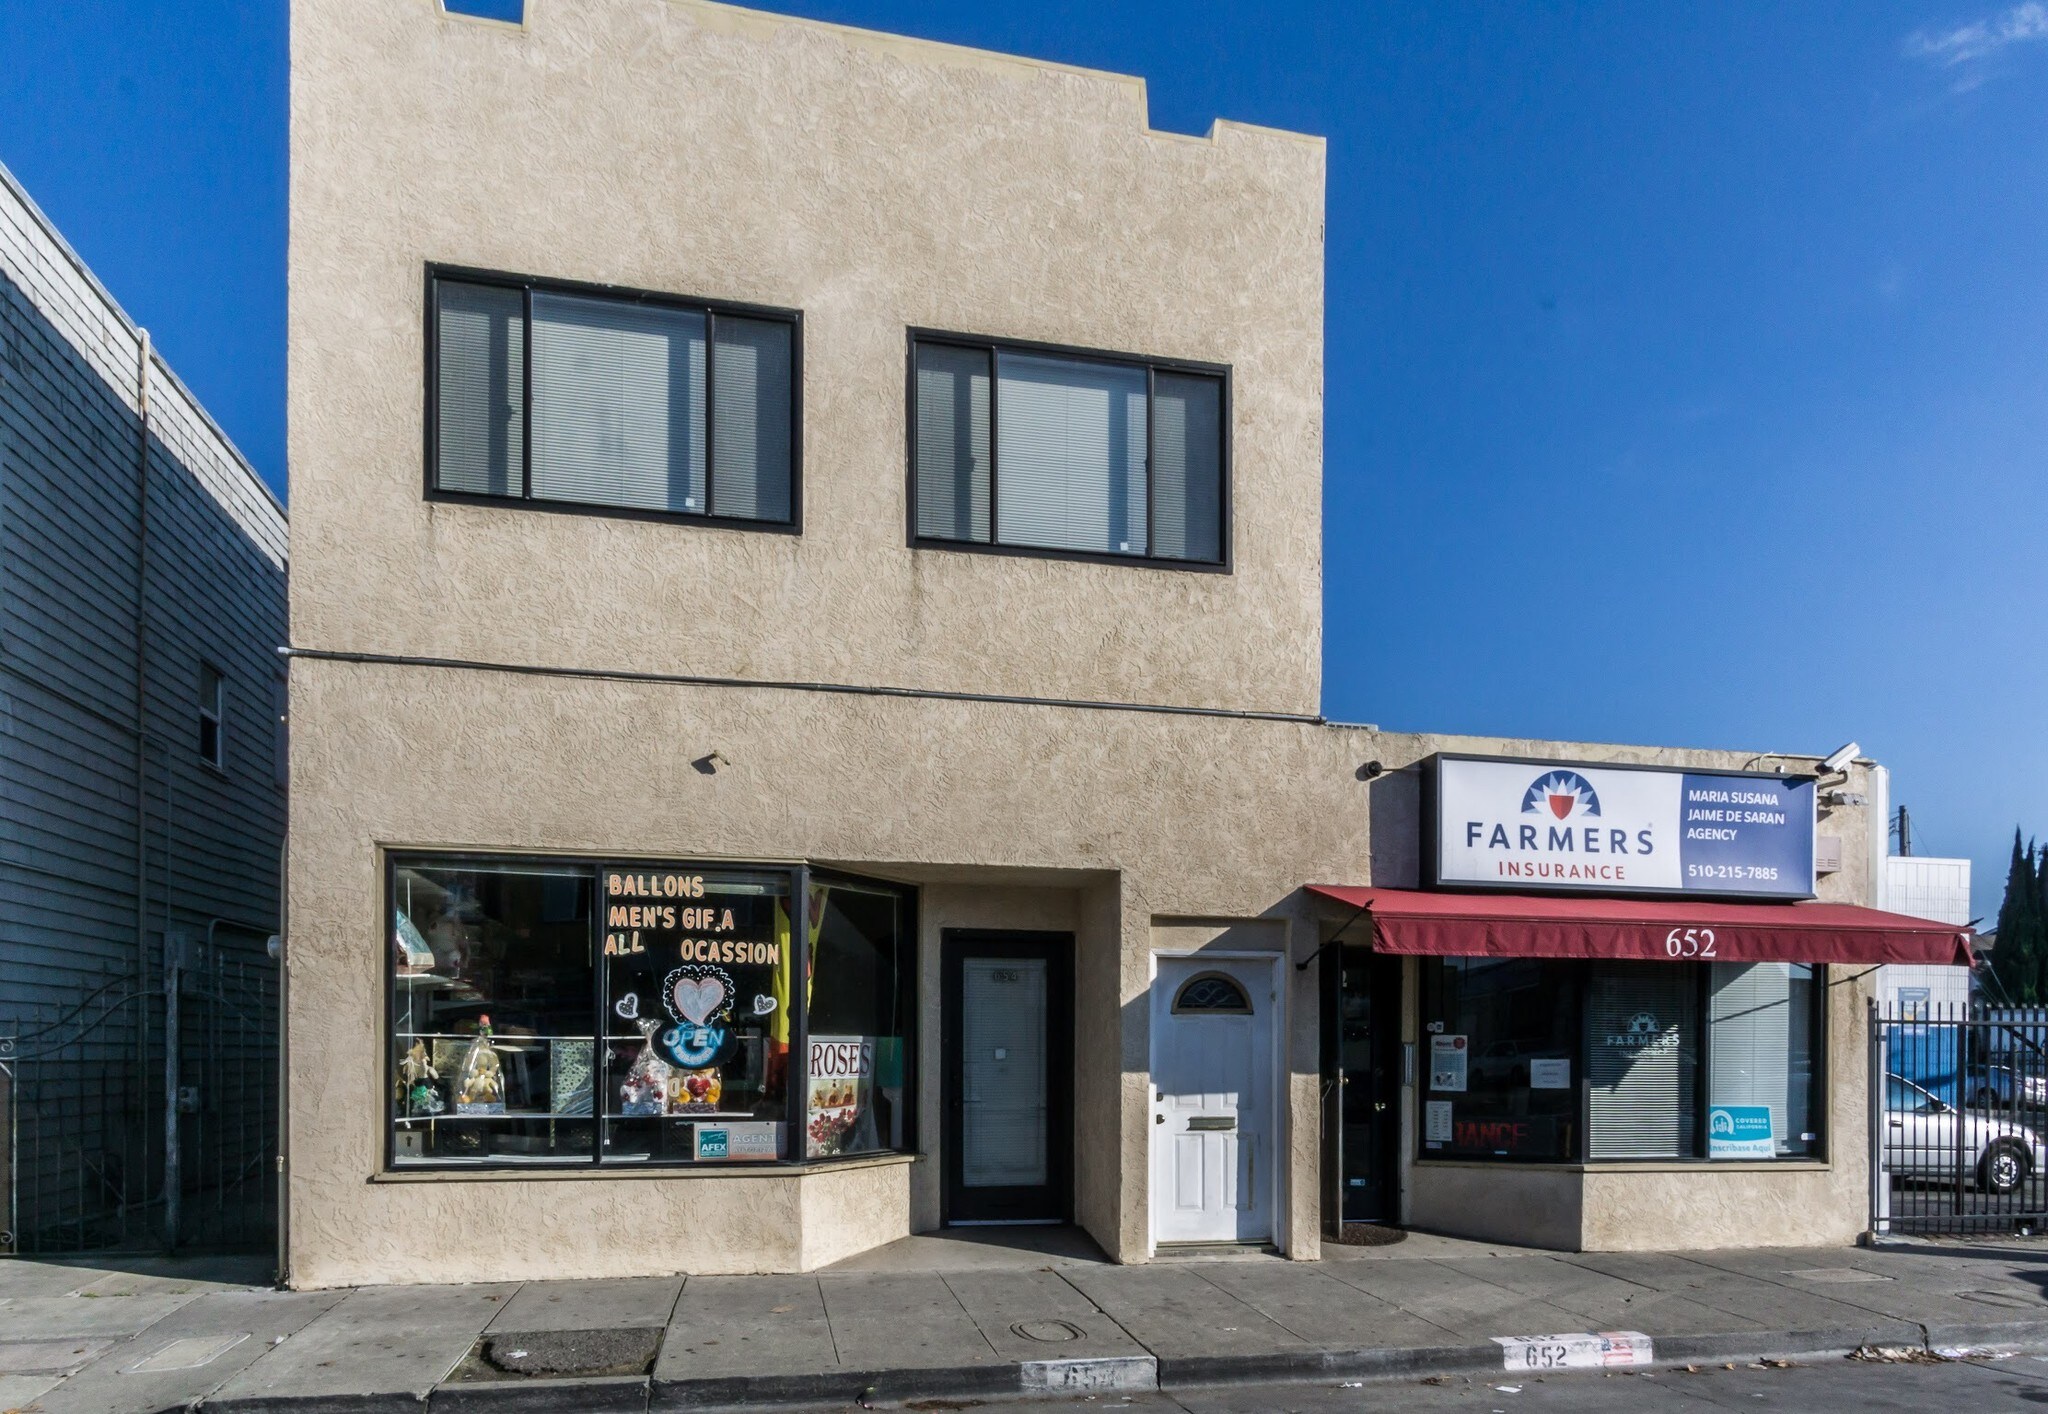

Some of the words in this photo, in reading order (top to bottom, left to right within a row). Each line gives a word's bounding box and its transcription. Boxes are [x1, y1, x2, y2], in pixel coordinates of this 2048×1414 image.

[1689, 790, 1729, 803] MARIA
[1731, 792, 1778, 806] SUSANA
[1688, 809, 1723, 822] JAIME
[1726, 810, 1742, 823] DE
[1744, 811, 1785, 825] SARAN
[1467, 822, 1653, 855] FARMERS
[1687, 828, 1737, 840] AGENCY
[1499, 861, 1625, 880] INSURANCE
[1688, 864, 1778, 880] 510-215-7885
[609, 874, 704, 898] BALLONS
[609, 906, 676, 929] MEN'S
[604, 930, 645, 956] ALL
[680, 938, 779, 965] OCASSION
[1666, 928, 1717, 957] 652
[663, 1028, 725, 1047] OPEN
[1606, 1033, 1680, 1046] FARMERS
[810, 1044, 871, 1077] ROSES
[702, 1143, 726, 1152] AFEX
[733, 1134, 784, 1143] AGENTE
[1526, 1343, 1567, 1368] 652
